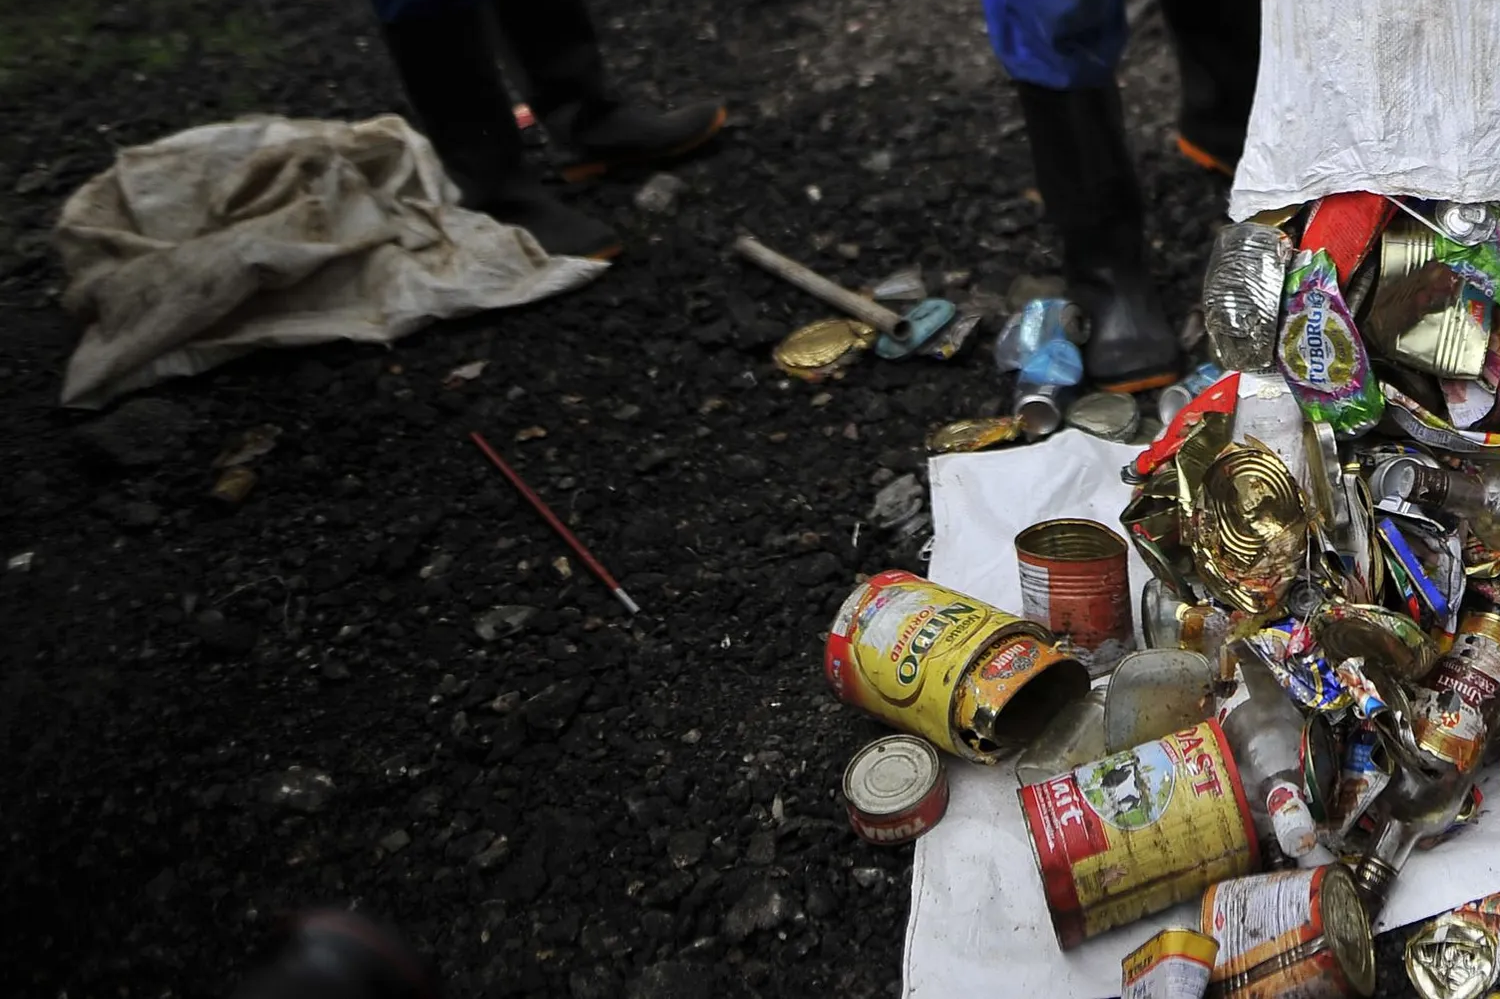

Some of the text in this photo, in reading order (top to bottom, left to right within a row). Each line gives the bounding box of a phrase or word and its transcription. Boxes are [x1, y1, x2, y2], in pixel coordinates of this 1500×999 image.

[1307, 310, 1327, 384] TUBORG
[890, 605, 936, 663] FORTIFIED
[897, 602, 977, 685] NIDO
[991, 643, 1027, 670] DRUK
[859, 817, 925, 841] TUNA
